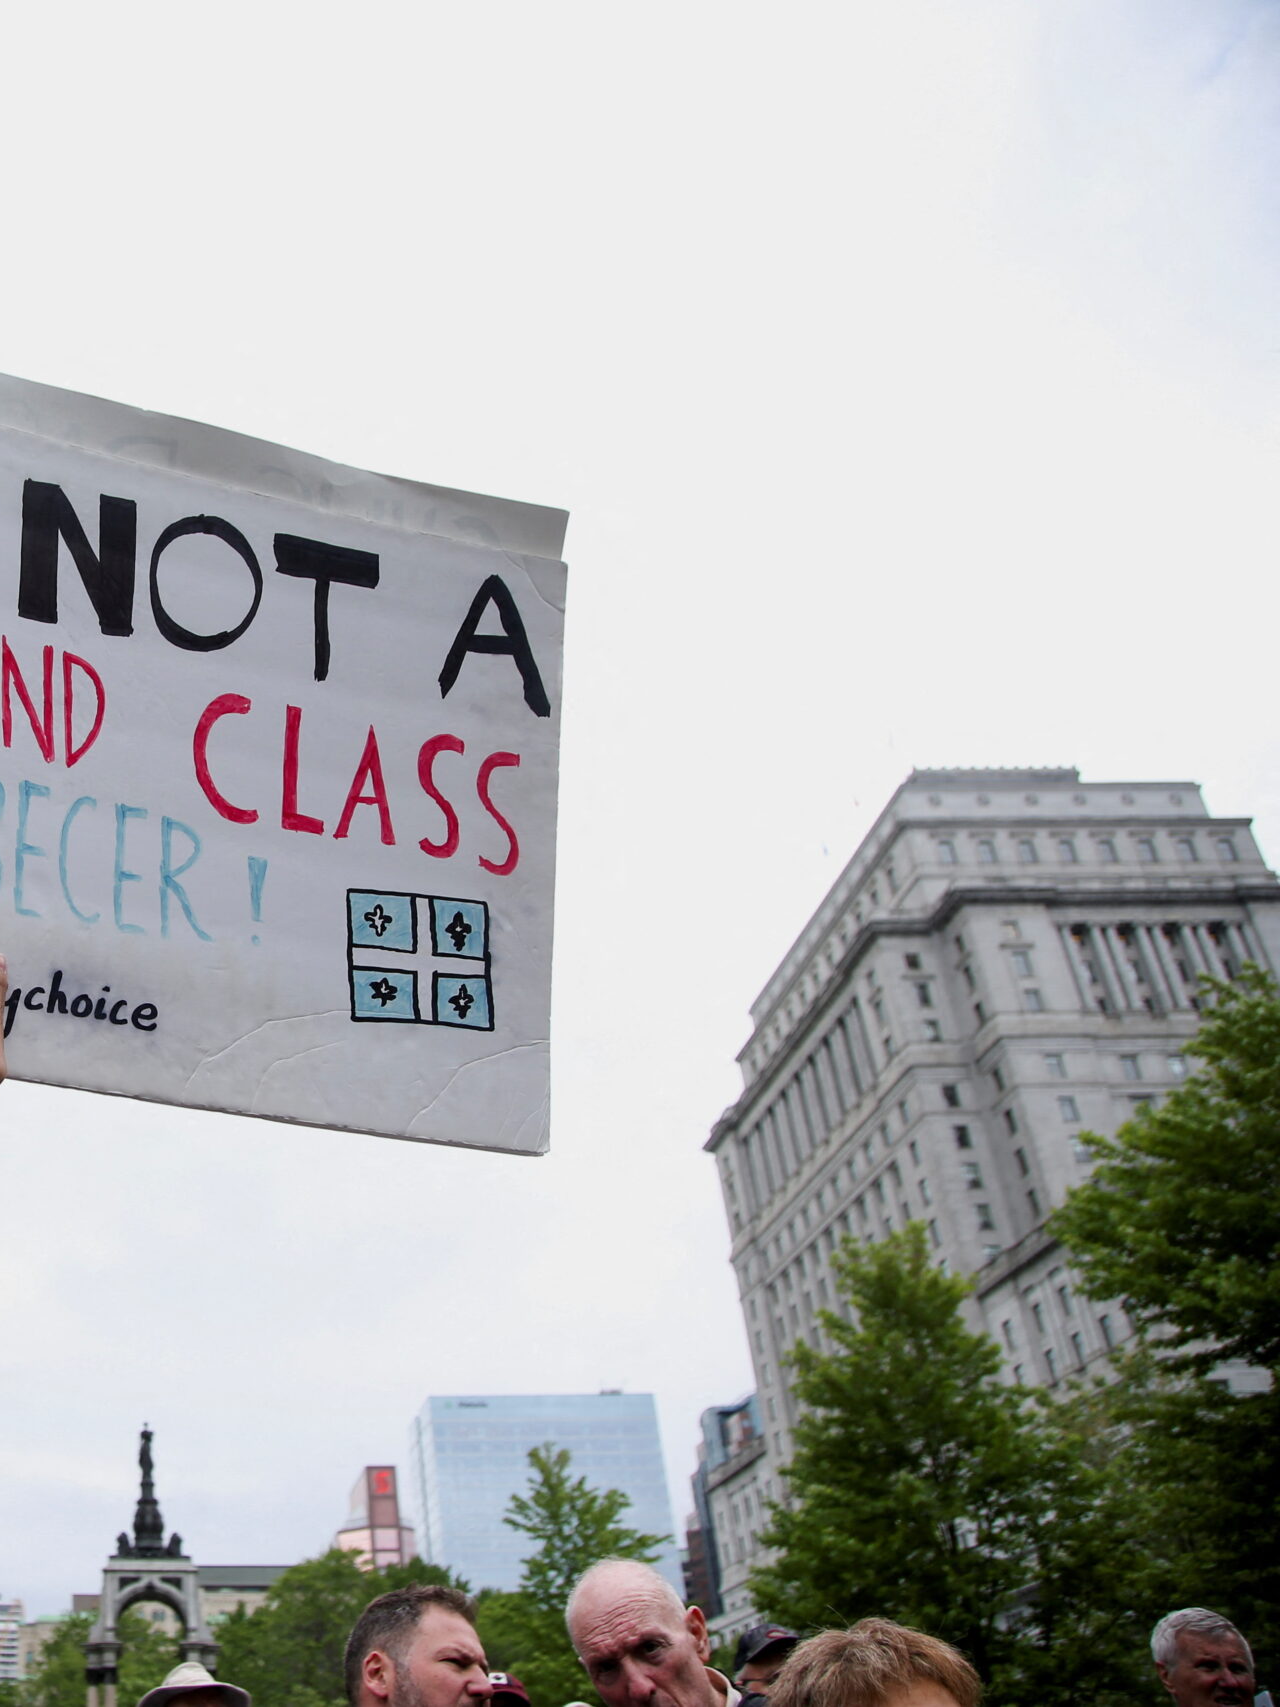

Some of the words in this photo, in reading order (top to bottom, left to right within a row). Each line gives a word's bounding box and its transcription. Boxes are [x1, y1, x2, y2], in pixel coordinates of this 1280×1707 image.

[17, 477, 380, 683] NOT
[437, 574, 552, 718] A
[193, 693, 521, 876] CLASS
